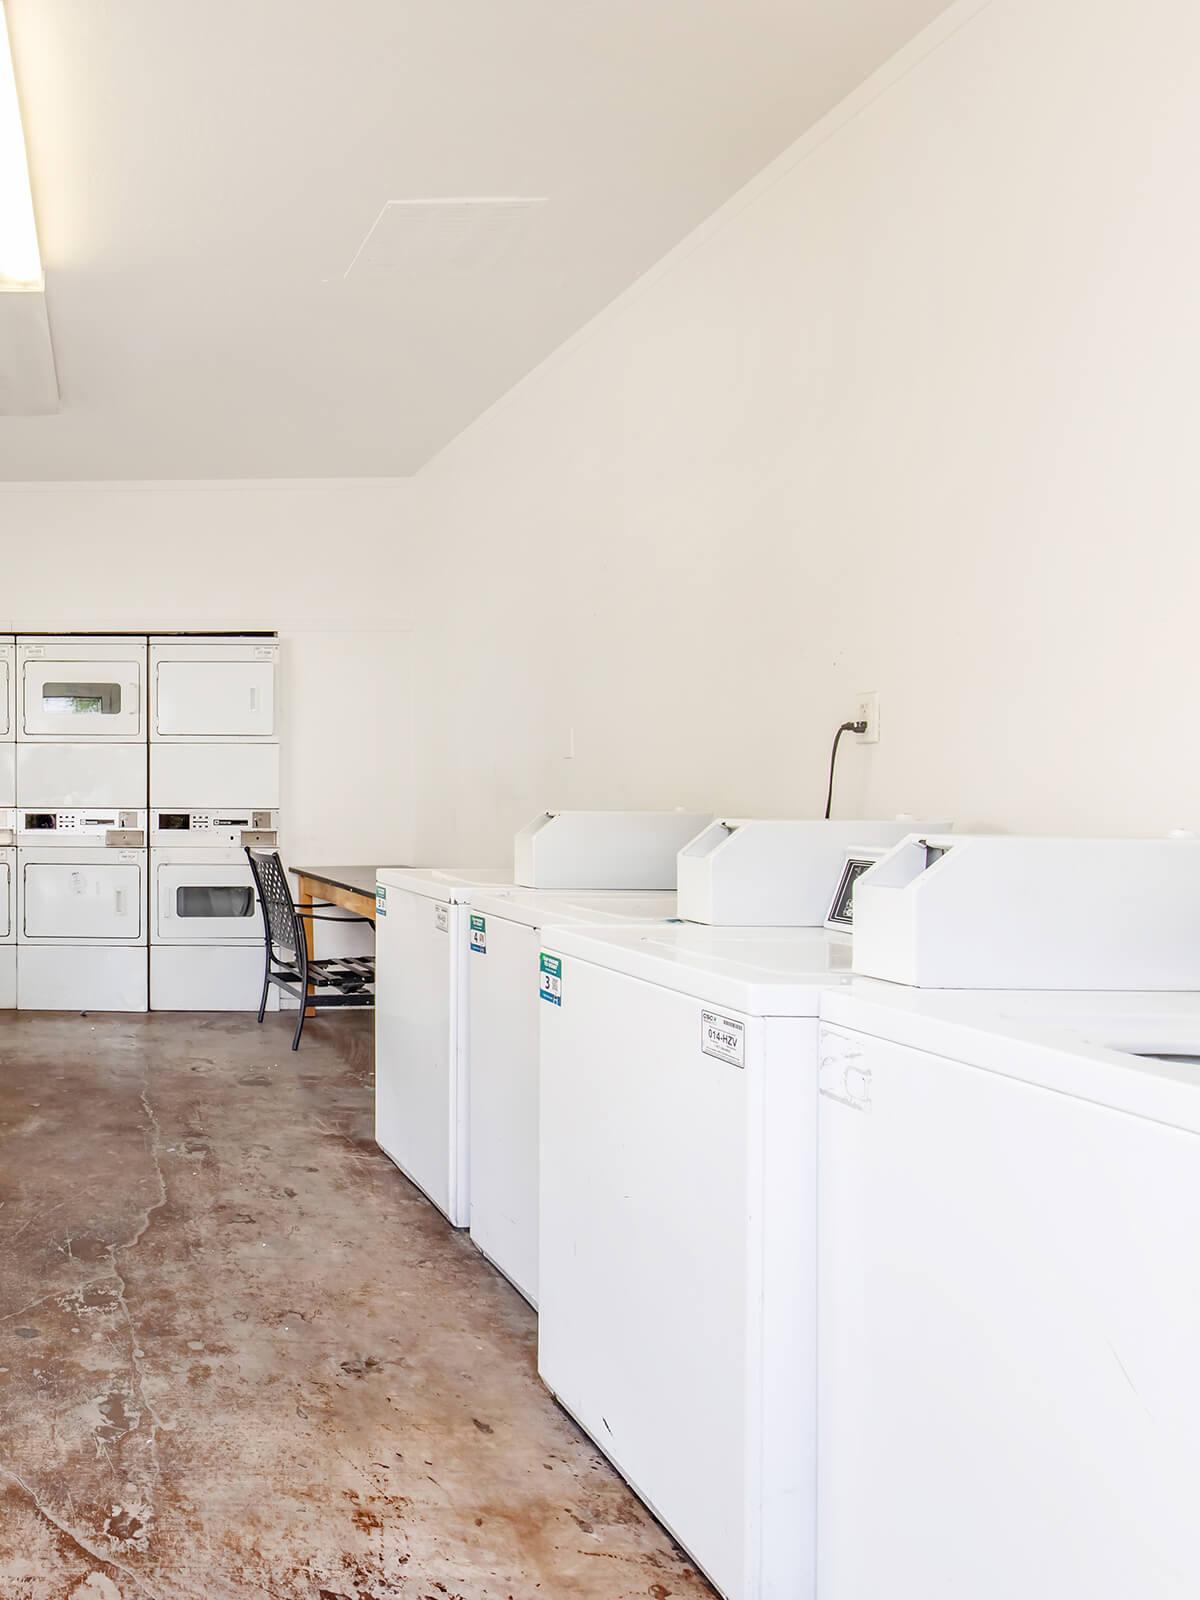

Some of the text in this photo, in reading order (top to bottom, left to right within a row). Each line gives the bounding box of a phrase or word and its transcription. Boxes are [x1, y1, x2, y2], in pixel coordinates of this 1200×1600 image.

[473, 932, 478, 943] 4
[545, 975, 550, 989] 3
[708, 1029, 737, 1047] 014-HZV
